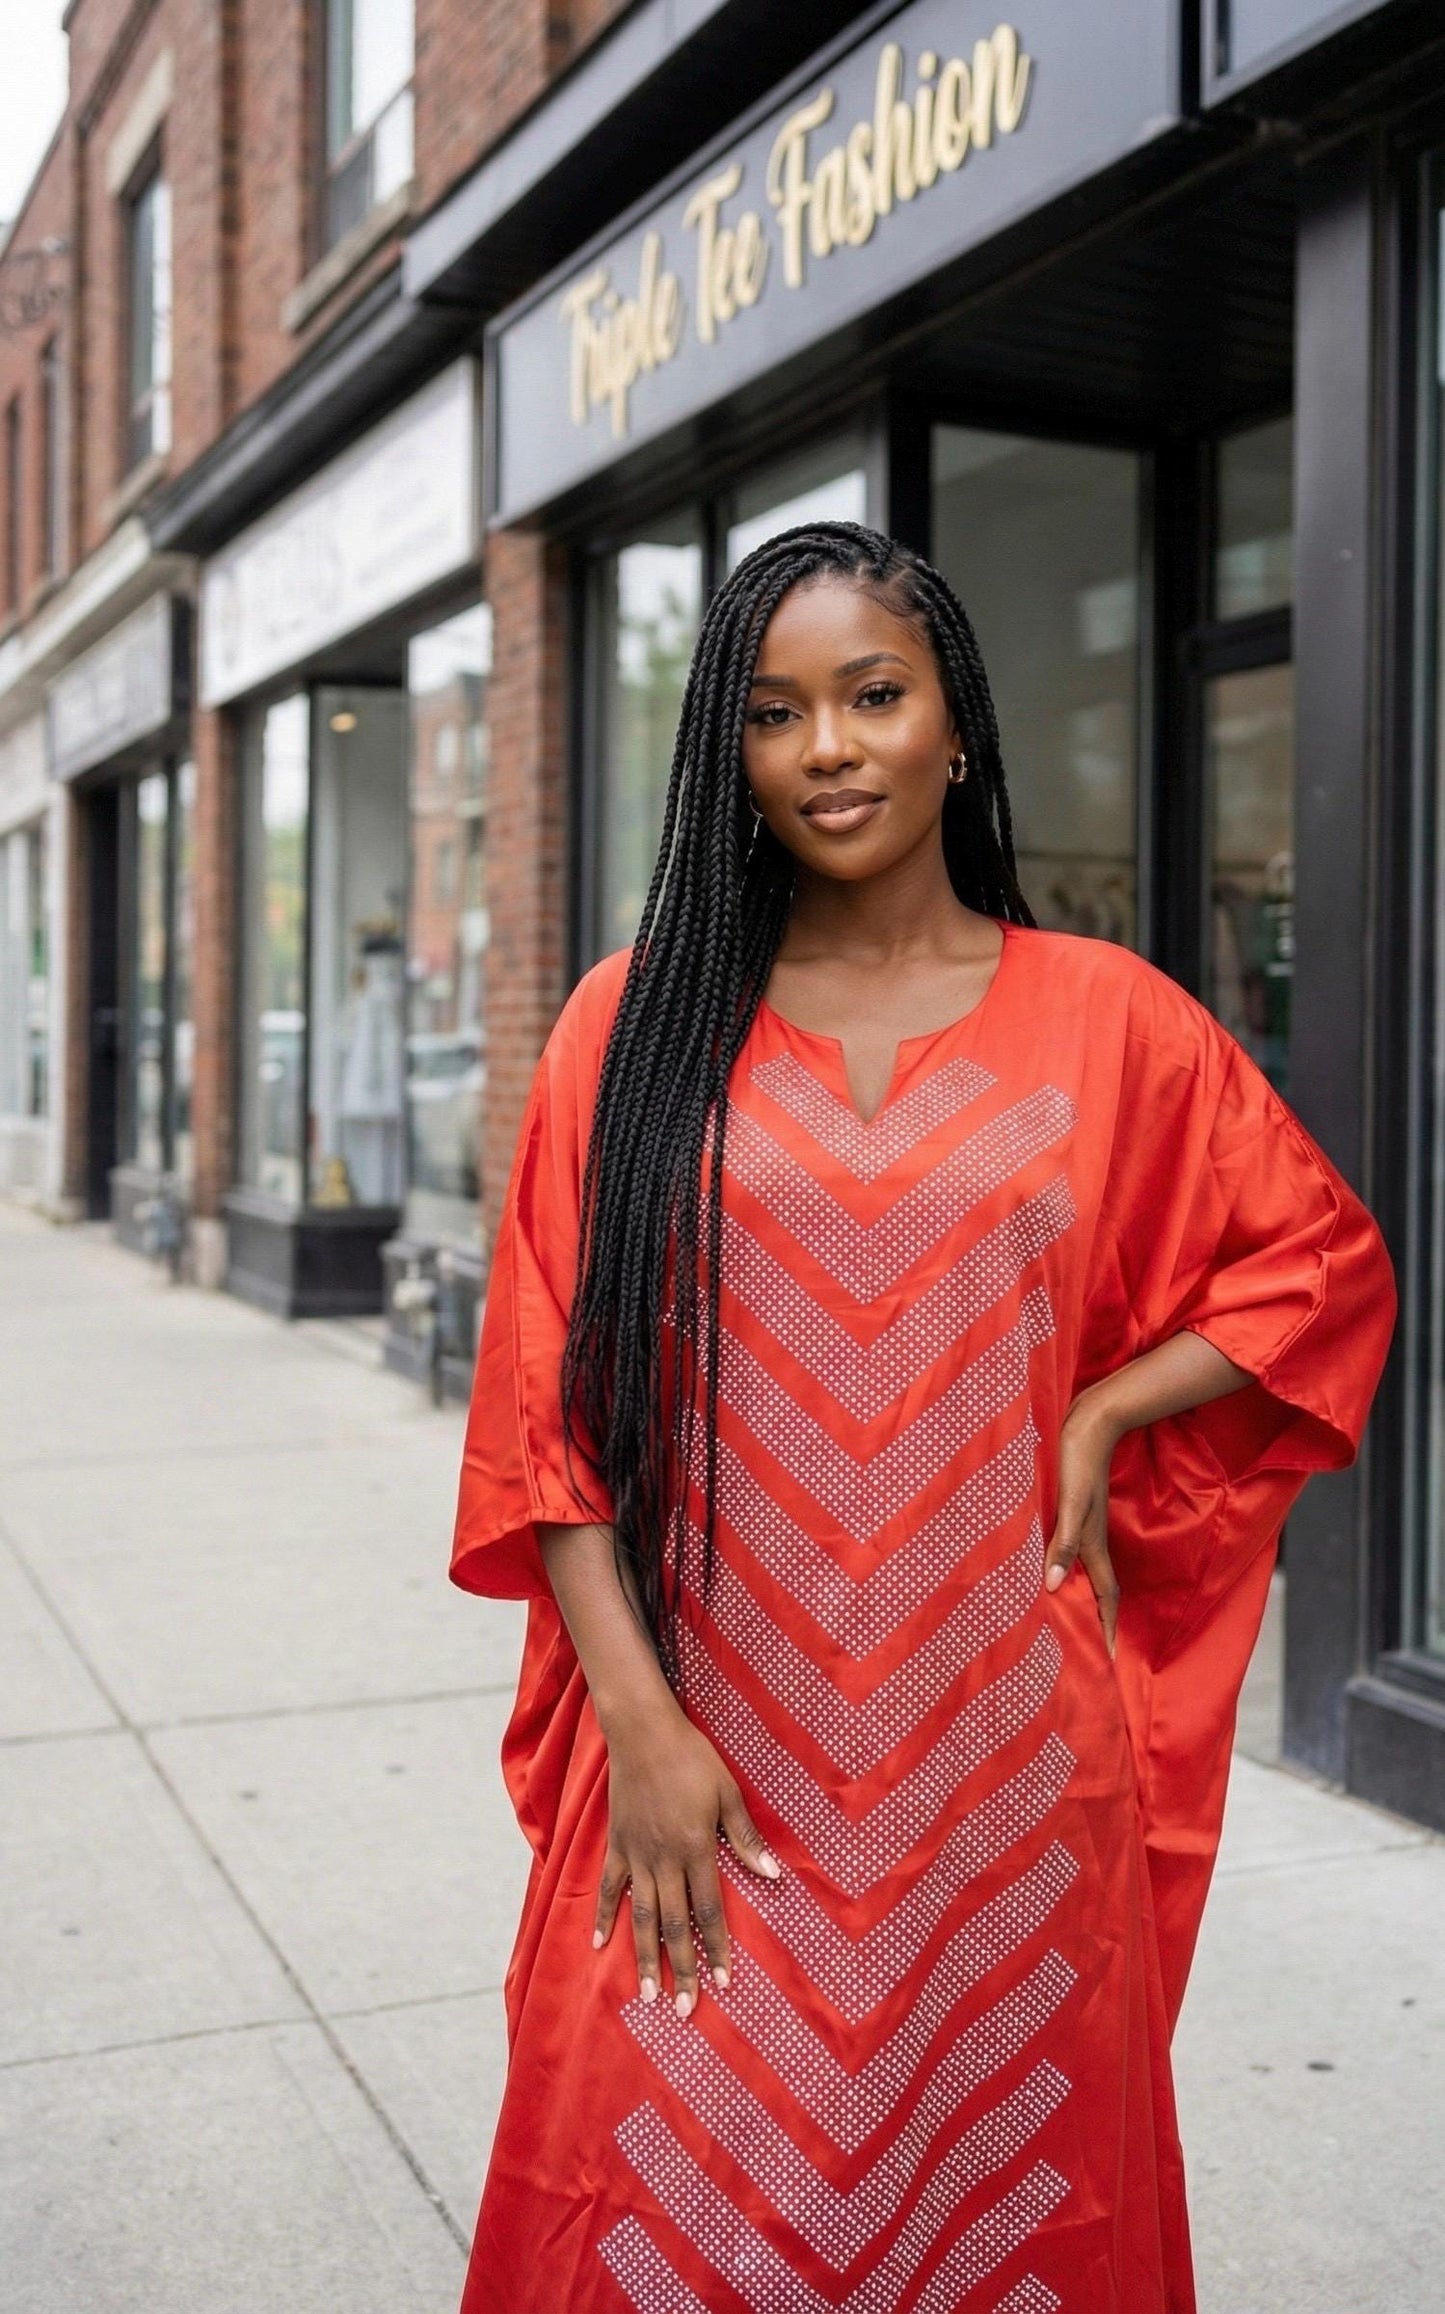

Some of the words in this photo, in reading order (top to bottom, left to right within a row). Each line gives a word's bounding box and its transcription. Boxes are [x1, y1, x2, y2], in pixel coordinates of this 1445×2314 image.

[561, 231, 682, 438] Triple
[682, 163, 768, 342] Tee
[767, 23, 1031, 288] Fashion
